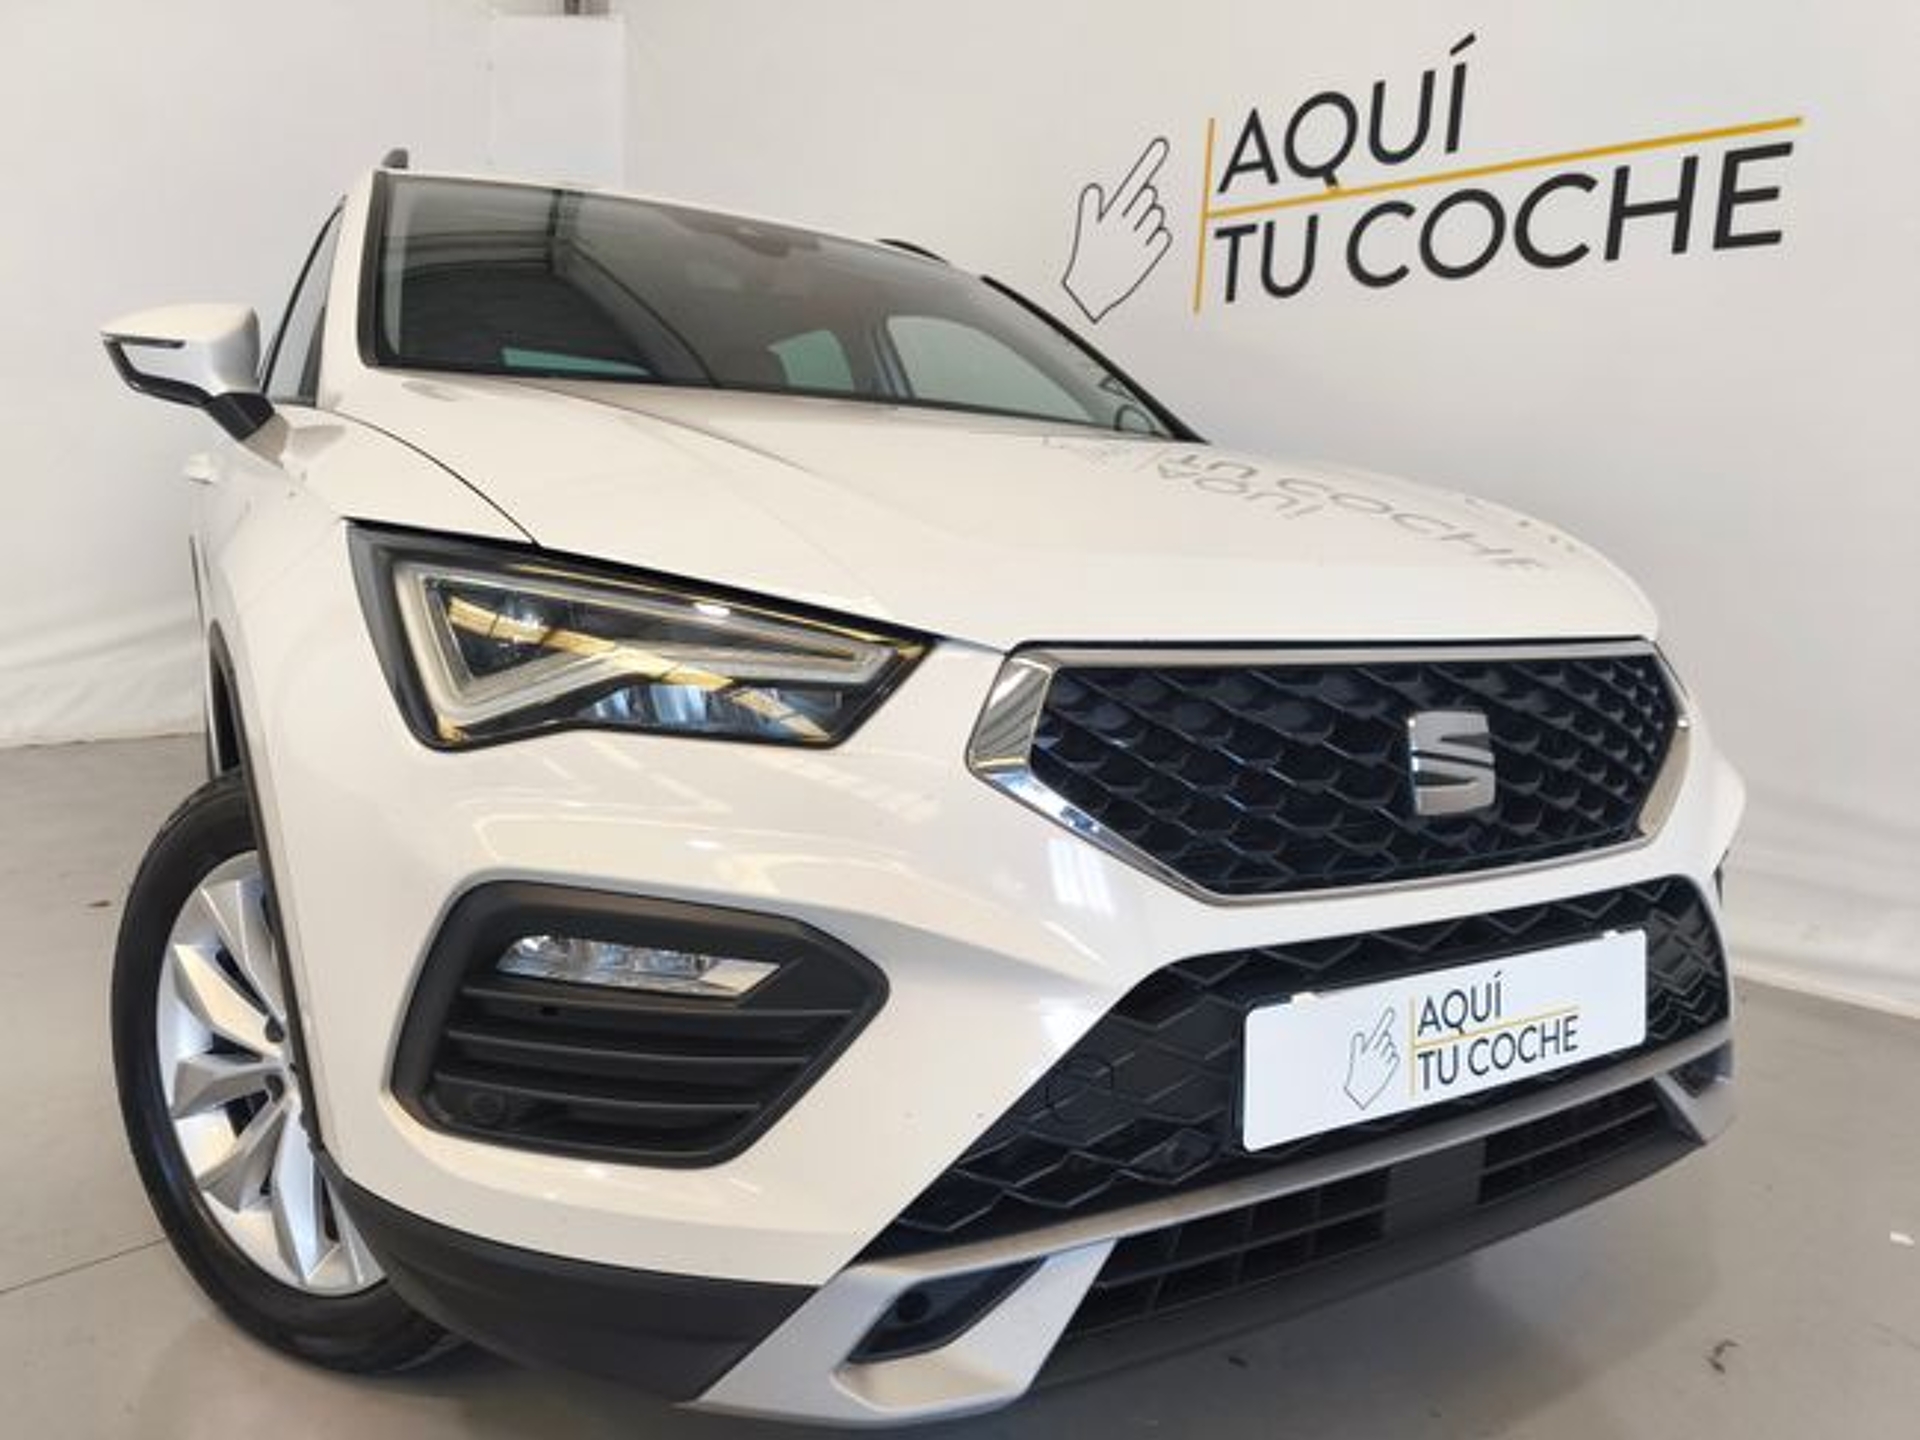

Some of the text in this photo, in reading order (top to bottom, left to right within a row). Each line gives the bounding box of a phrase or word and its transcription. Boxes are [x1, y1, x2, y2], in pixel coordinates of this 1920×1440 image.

[1217, 32, 1477, 189] AQUÍ
[1214, 141, 1794, 303] TU COCHE
[1418, 971, 1502, 1036] AQUÍ
[1418, 1015, 1579, 1090] TU COCHE
